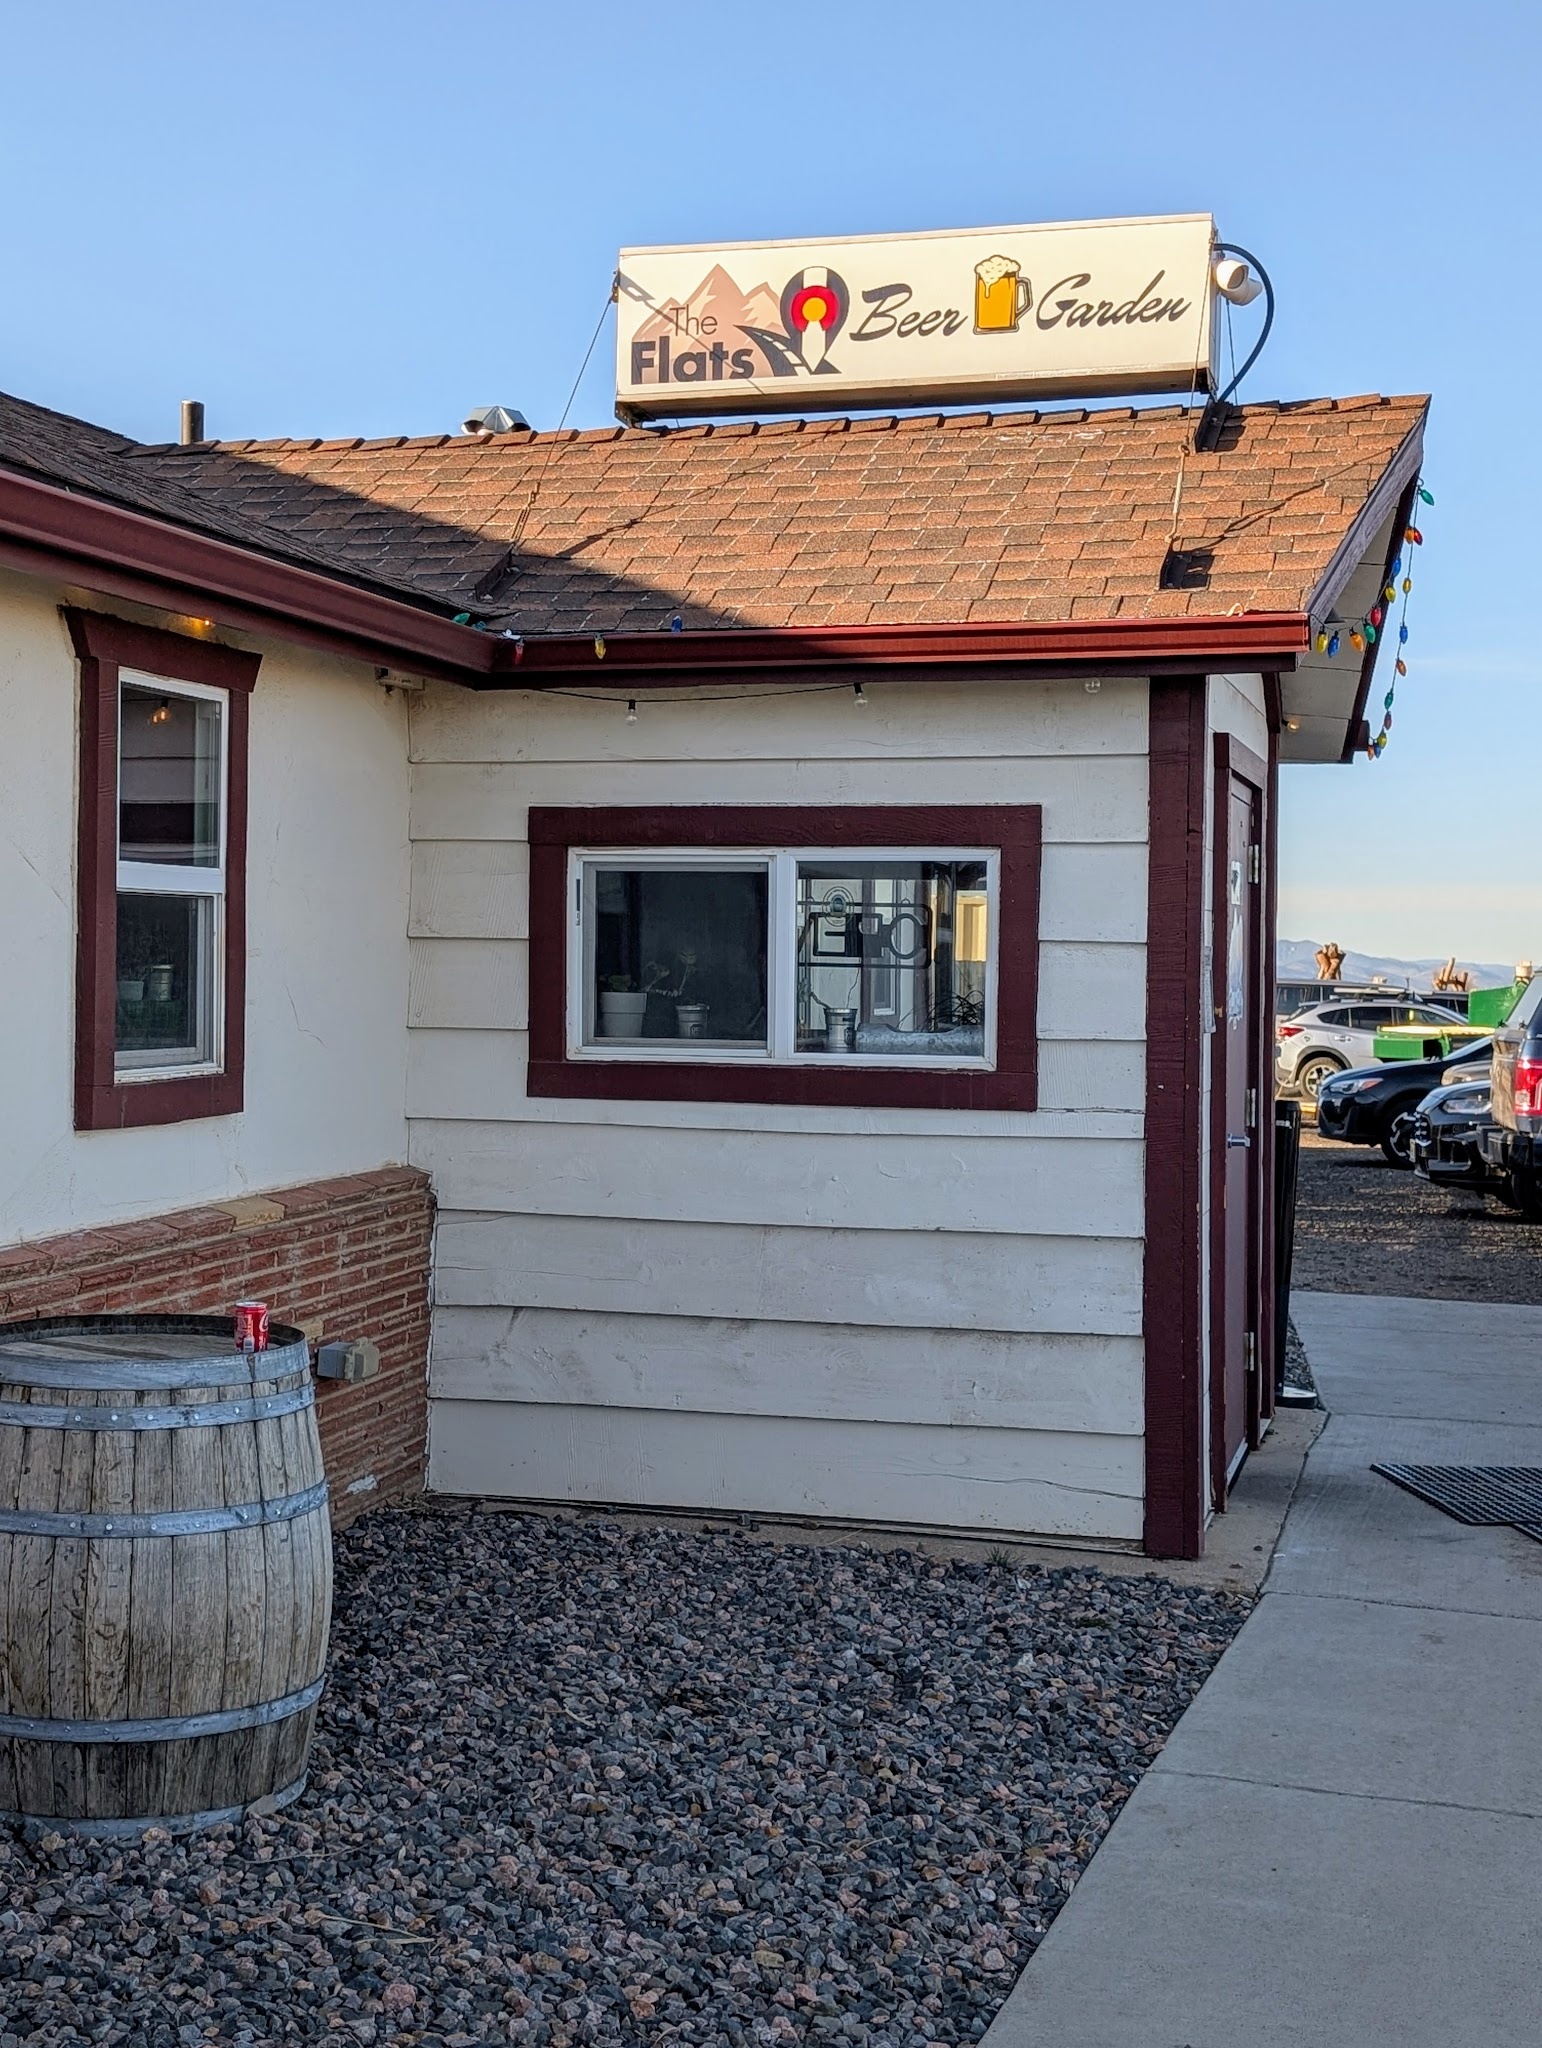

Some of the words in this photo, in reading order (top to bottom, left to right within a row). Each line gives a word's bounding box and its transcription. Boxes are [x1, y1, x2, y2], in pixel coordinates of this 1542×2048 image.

[669, 304, 718, 337] The
[849, 282, 969, 341] Beer
[1036, 270, 1191, 330] Garden
[631, 336, 755, 385] Flats
